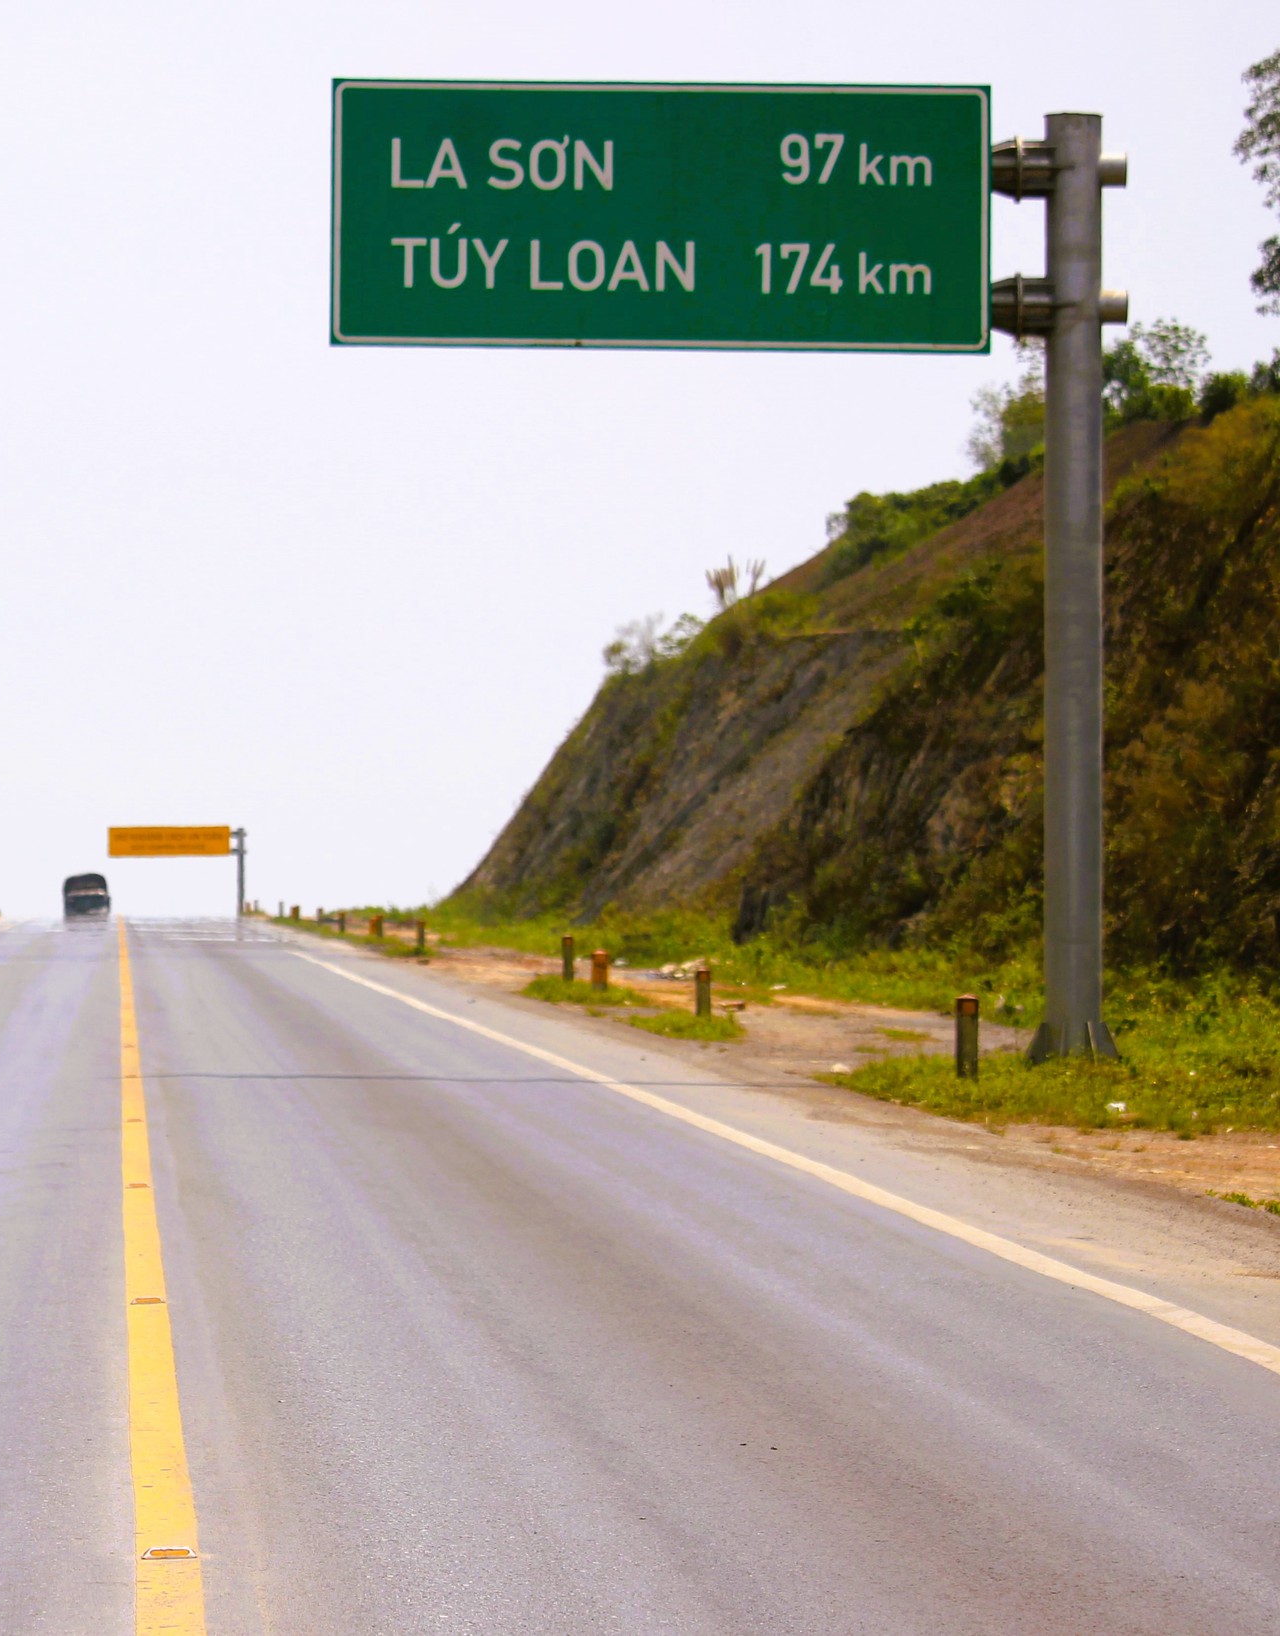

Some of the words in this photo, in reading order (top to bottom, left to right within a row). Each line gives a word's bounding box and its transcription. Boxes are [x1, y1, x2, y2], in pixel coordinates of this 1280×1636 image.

[391, 138, 467, 189] LA
[488, 135, 614, 190] SƠN
[780, 134, 844, 185] 97
[858, 143, 932, 186] km
[391, 223, 508, 290] TÚY
[530, 239, 696, 291] LOAN
[754, 242, 843, 294] 174
[858, 251, 932, 294] km
